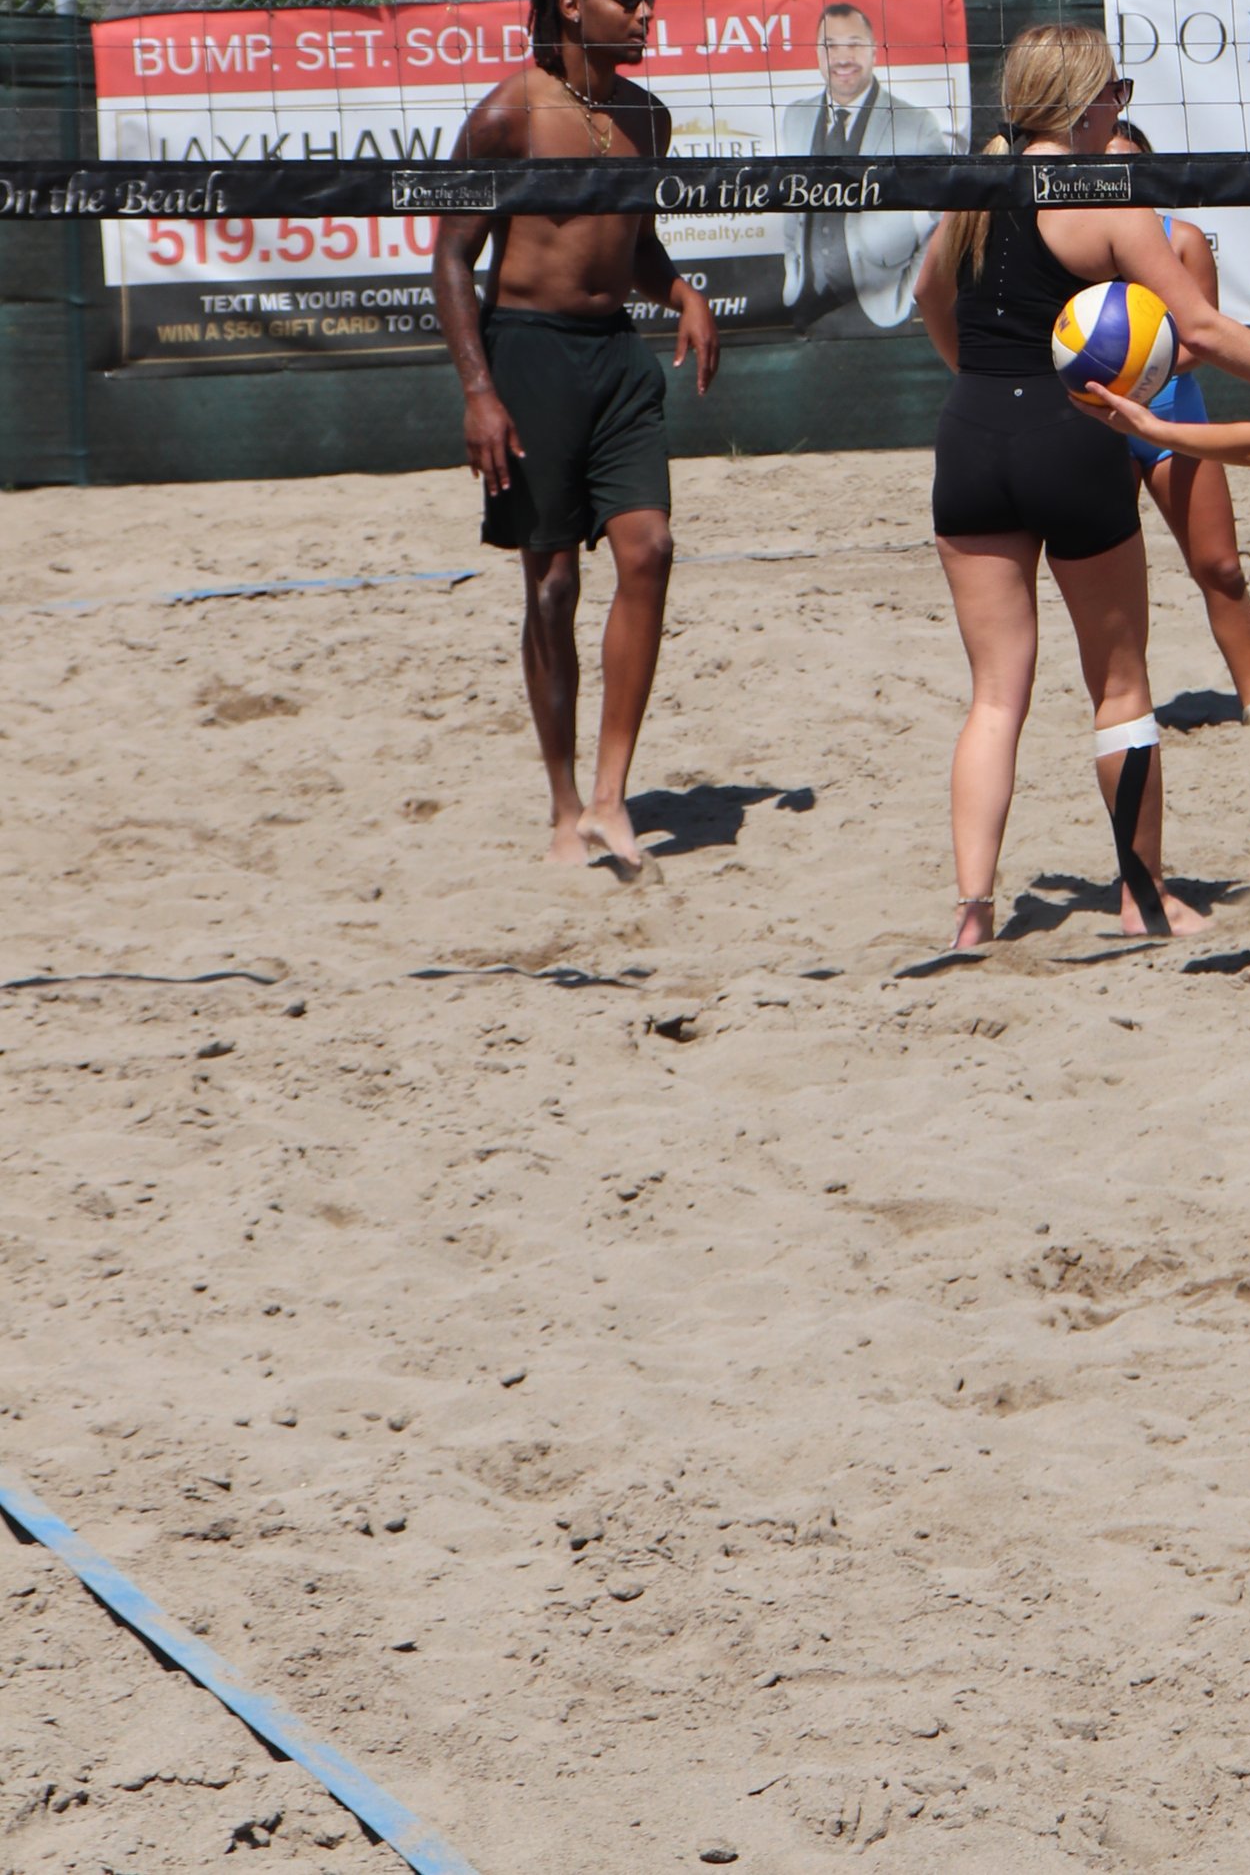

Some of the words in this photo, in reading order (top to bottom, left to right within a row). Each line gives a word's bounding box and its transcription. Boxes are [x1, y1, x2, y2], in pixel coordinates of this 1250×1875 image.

[132, 33, 282, 76] BUMP.
[296, 29, 391, 71] SET.
[695, 14, 793, 55] JAY!
[49, 170, 106, 214] the
[115, 170, 228, 214] Beach
[655, 175, 709, 209] On
[718, 166, 770, 208] the
[779, 165, 882, 207] Beach
[1052, 179, 1070, 193] On
[1092, 176, 1128, 192] Beach
[148, 216, 442, 266] 519.551.0
[200, 294, 257, 314] TEXT
[259, 292, 293, 311] ME
[295, 289, 355, 311] YOUR
[361, 287, 435, 308] CONTA
[157, 323, 200, 344] WIN
[204, 322, 221, 342] A
[223, 319, 263, 342] $50
[269, 318, 317, 338] GIFT
[321, 315, 380, 336] CARD
[385, 314, 414, 333] TO
